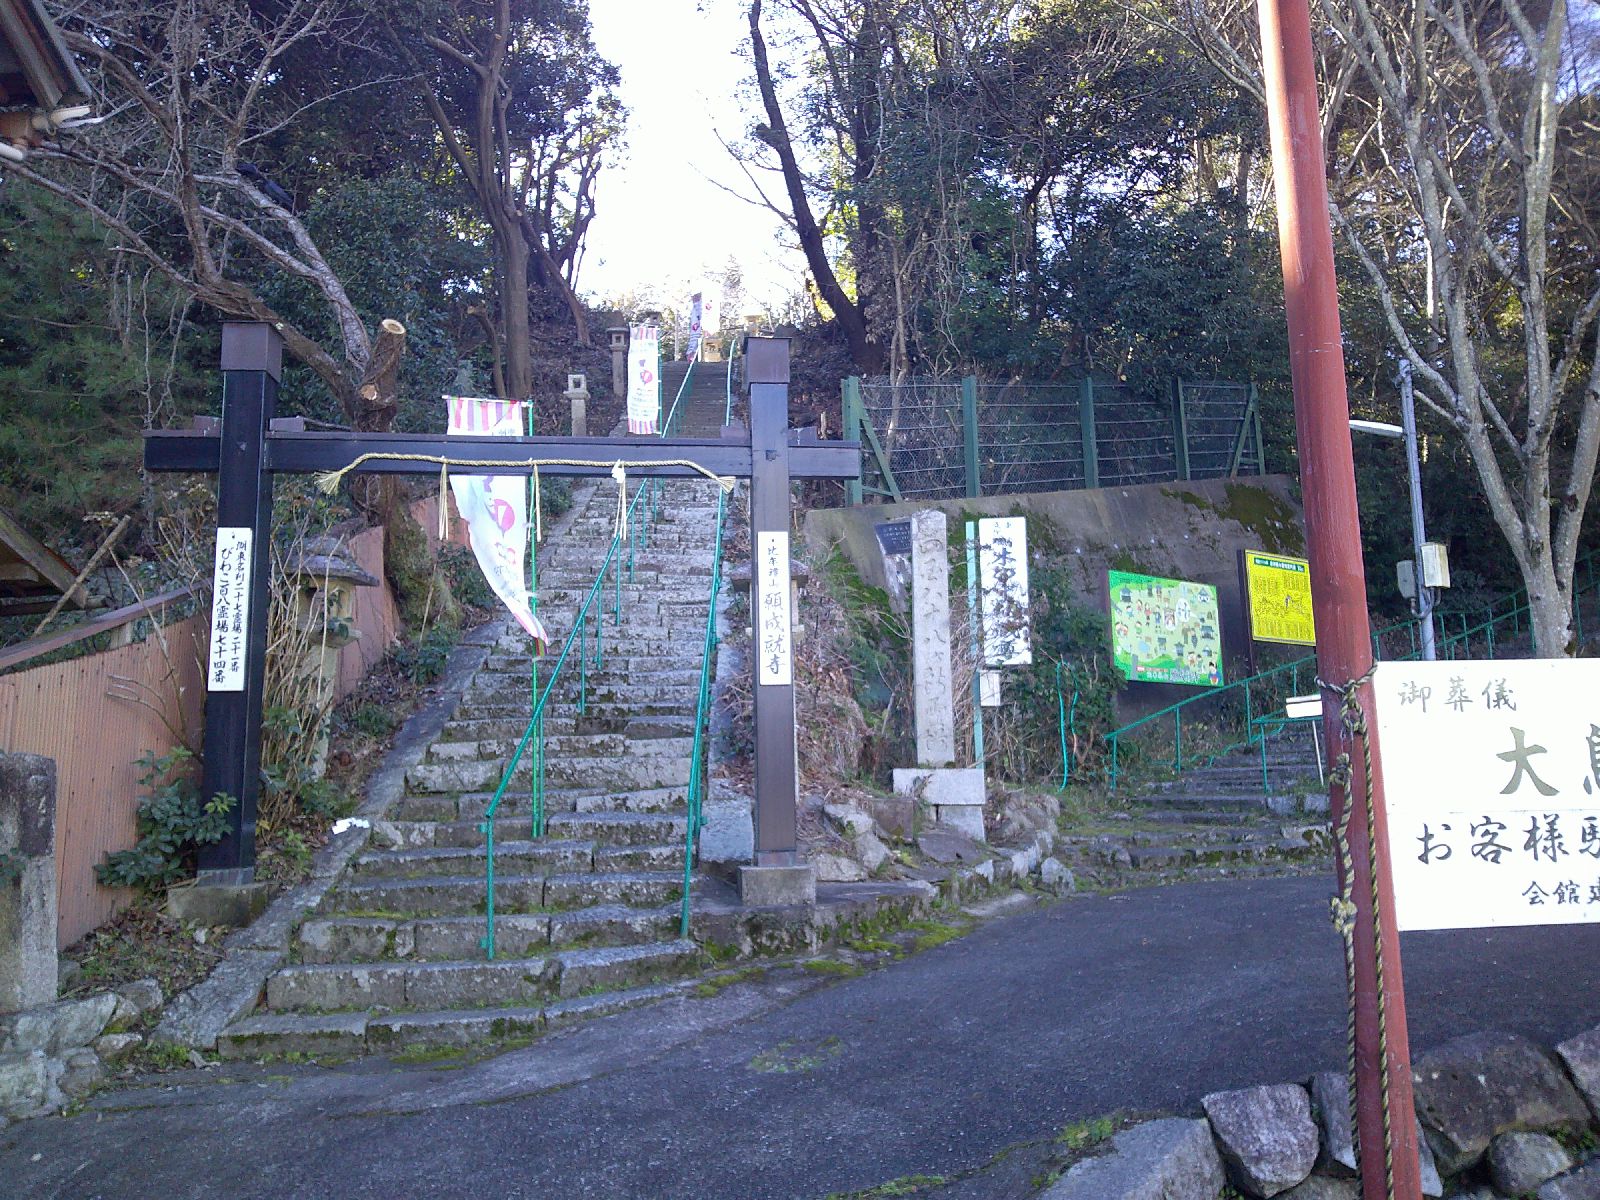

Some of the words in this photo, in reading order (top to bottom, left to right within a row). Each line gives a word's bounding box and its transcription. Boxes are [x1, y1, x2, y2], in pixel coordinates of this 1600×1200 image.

[1397, 675, 1517, 713] 御葬儀
[1496, 723, 1600, 797] 大
